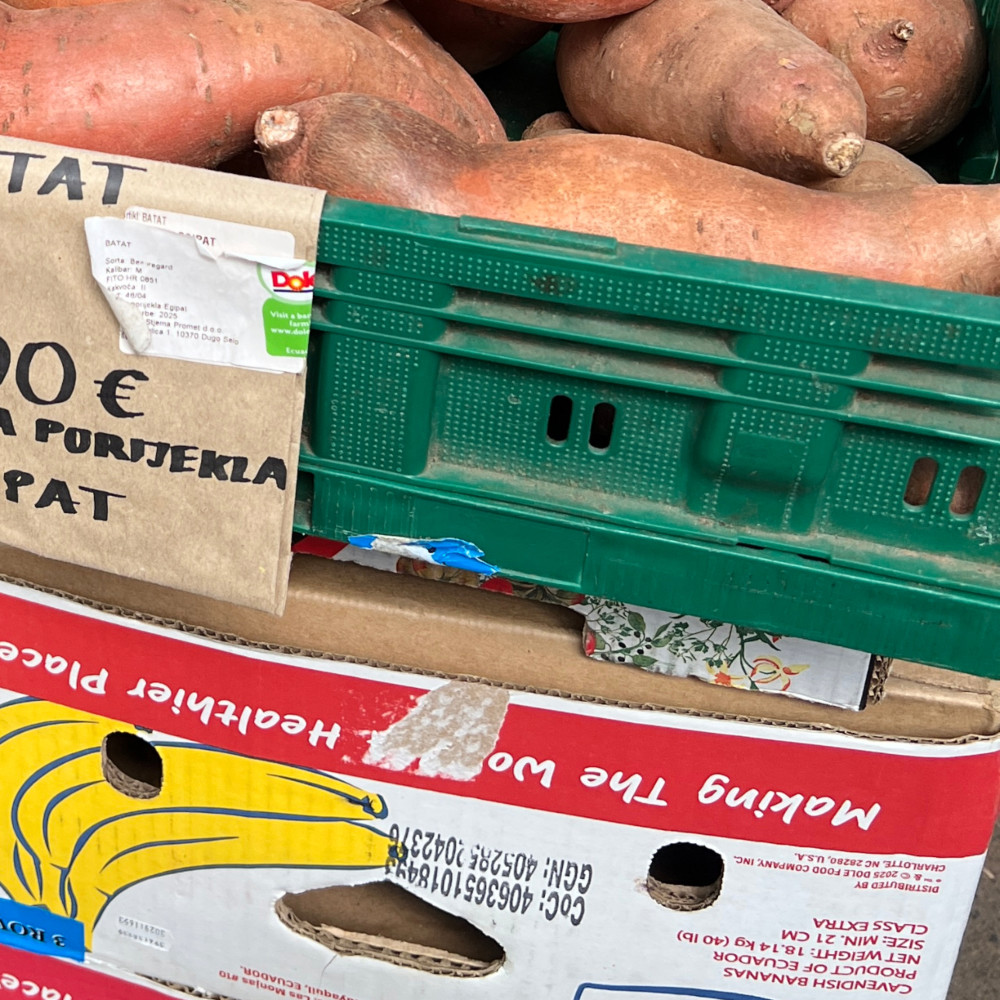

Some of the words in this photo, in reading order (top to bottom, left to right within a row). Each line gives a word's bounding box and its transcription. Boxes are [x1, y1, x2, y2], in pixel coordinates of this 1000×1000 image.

[105, 240, 132, 248] BATAT
[270, 310, 288, 319] Visit
[174, 321, 200, 331] Promet
[35, 418, 287, 491] PORIJEKLA
[126, 677, 341, 750] Healthier
[579, 766, 668, 808] The
[697, 773, 881, 832] Making
[733, 855, 754, 866] INC.
[794, 852, 825, 863] U.S.A.
[829, 857, 863, 867] 28280,
[865, 860, 879, 868] NC
[758, 860, 810, 872] COMPANY,
[812, 866, 841, 876] FOOD
[883, 860, 946, 872] CHARLOTTE,
[543, 856, 593, 895] GGN:
[843, 869, 871, 879] DOLE
[873, 870, 898, 878] 2025
[854, 880, 868, 889] BY
[871, 881, 939, 894] DISTRIBUTED
[538, 888, 586, 927] CoC:
[813, 918, 869, 932] EXTRA
[873, 920, 929, 935] CLASS
[51, 933, 66, 947] 3
[676, 929, 698, 944] lb)
[702, 934, 730, 947] (40
[781, 929, 810, 942] CM
[816, 933, 836, 945] 21
[841, 935, 878, 947] MIN.
[734, 936, 755, 951] kg
[882, 935, 925, 950] SIZE:
[760, 942, 805, 957] 18.14
[810, 948, 882, 962] WEIGHT:
[713, 951, 798, 971] ECUADOR
[885, 952, 921, 965] NET
[802, 962, 828, 974] OF
[831, 964, 917, 980] PRODUCT
[218, 970, 239, 982] #10
[239, 965, 302, 990] ECUADOR.
[723, 967, 808, 987] BANANAS
[242, 976, 286, 996] Monjas
[813, 978, 912, 995] CAVENDISH
